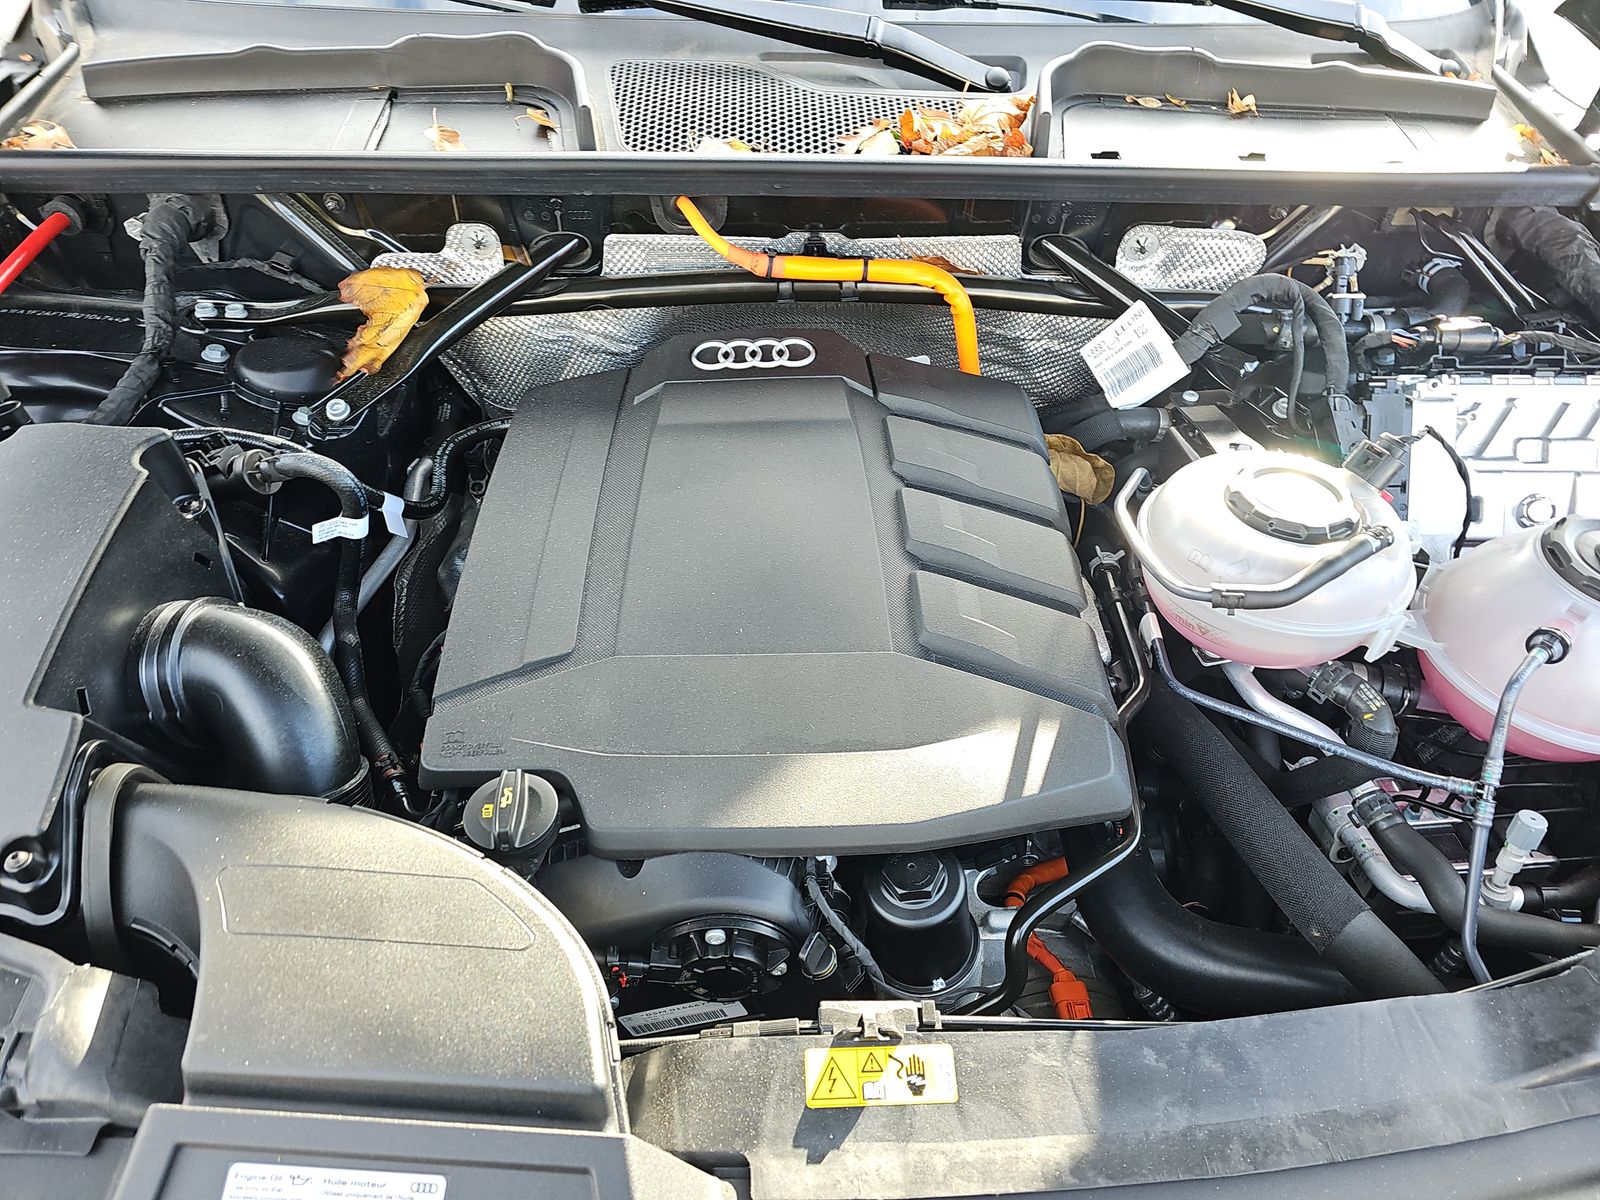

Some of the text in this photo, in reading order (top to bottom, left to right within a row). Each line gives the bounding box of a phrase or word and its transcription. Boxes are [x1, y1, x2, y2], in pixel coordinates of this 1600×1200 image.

[1115, 308, 1145, 336] LEONI
[323, 1178, 387, 1188] Huile moteur
